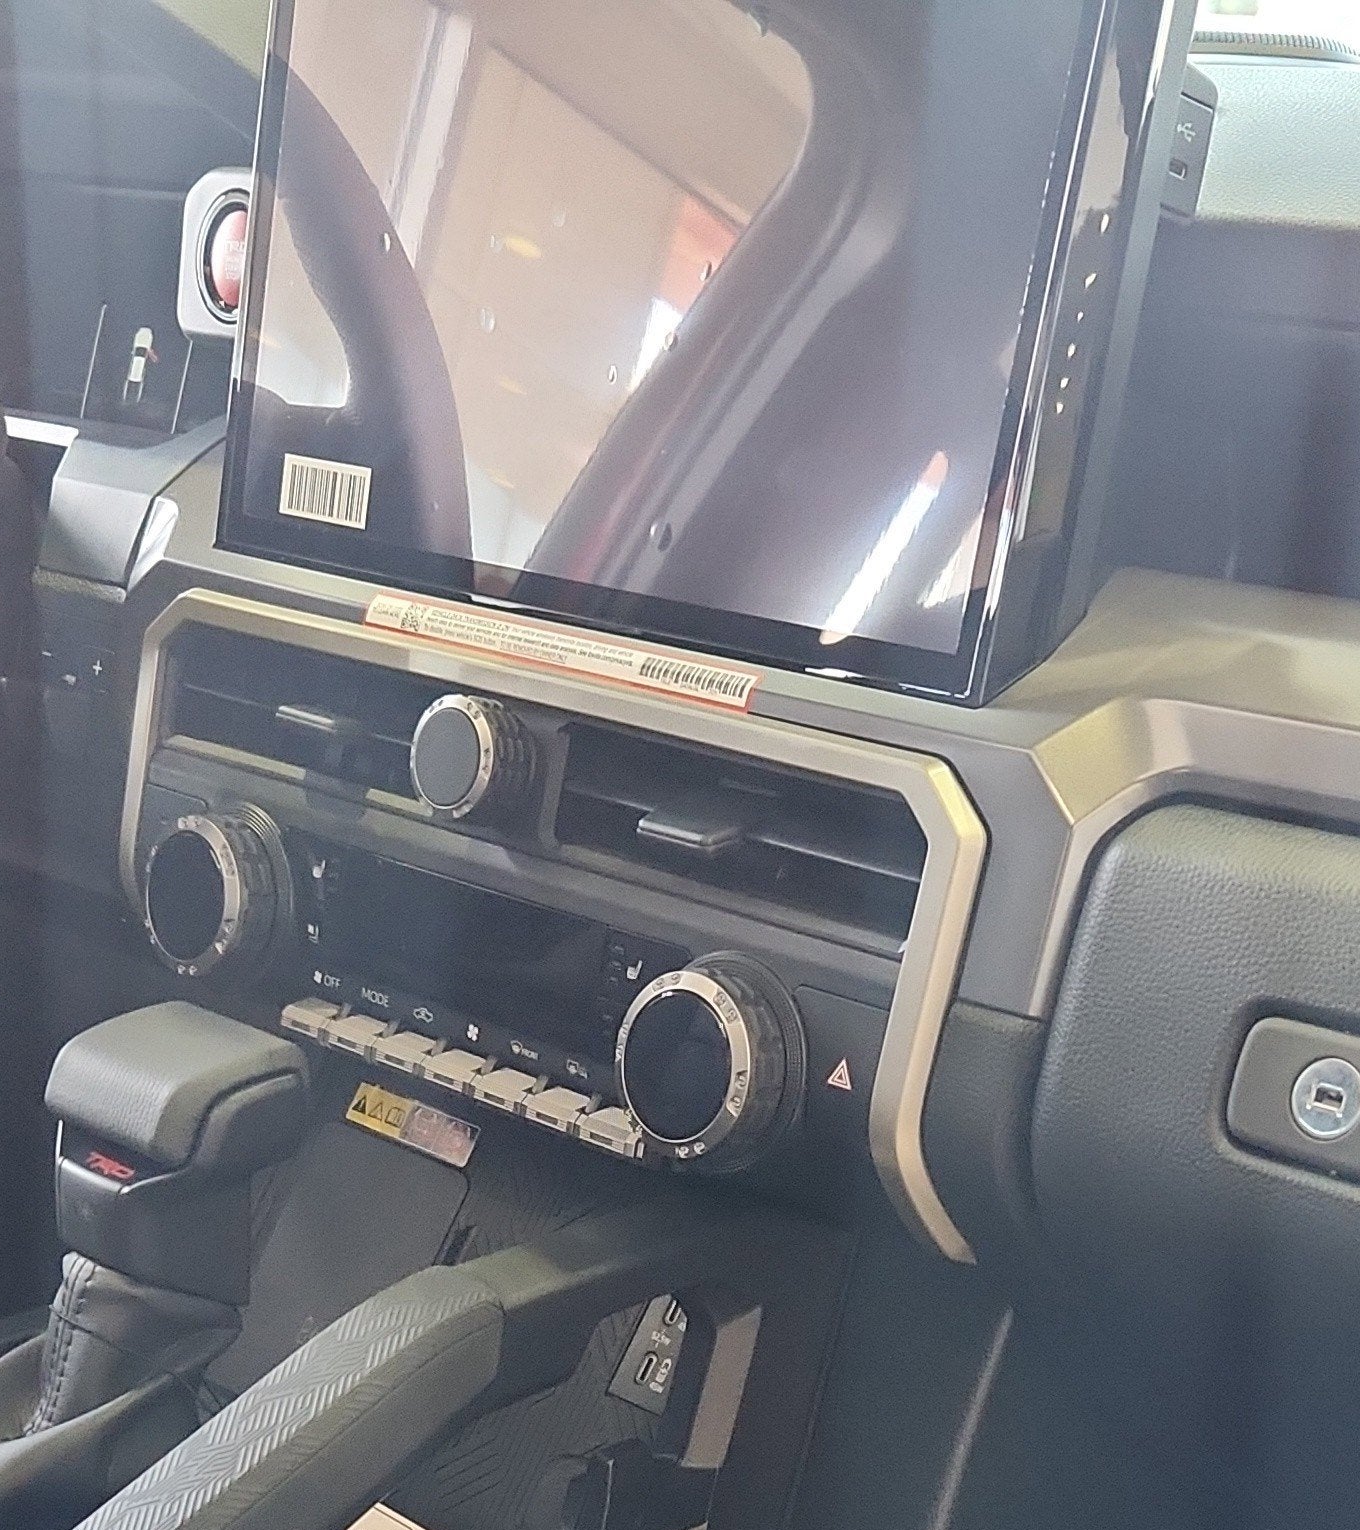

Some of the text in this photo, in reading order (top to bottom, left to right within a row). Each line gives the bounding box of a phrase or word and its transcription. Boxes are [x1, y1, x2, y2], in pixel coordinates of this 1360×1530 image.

[323, 974, 342, 989] OFF
[361, 986, 390, 1009] MODE
[86, 1150, 136, 1180] TRD
